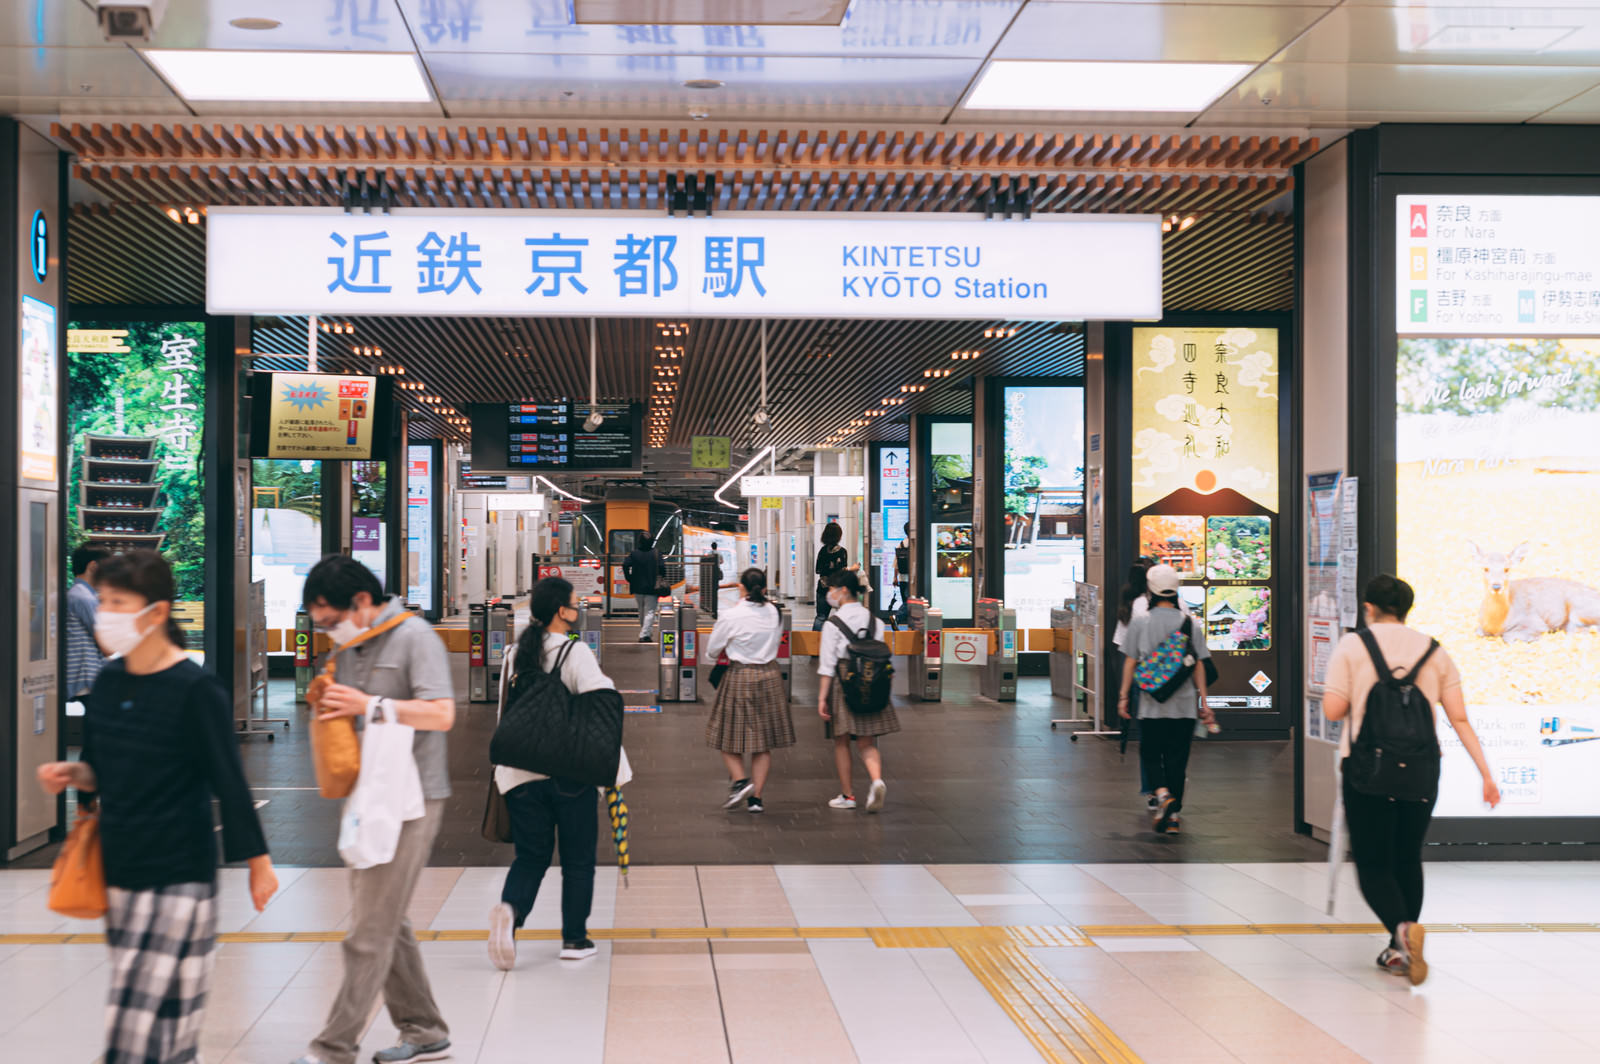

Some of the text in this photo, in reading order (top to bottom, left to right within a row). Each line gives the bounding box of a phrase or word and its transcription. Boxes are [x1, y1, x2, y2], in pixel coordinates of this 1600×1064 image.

[1412, 213, 1426, 230] A
[1436, 205, 1471, 222] 奈良
[1436, 225, 1496, 239] For Nara
[328, 231, 767, 299] 近鉄 京都駅
[843, 245, 981, 268] KINTETSU
[1412, 255, 1425, 272] B
[1437, 247, 1527, 265] 橿原神宮前
[1436, 266, 1593, 285] For Kashiharajingu-mae
[954, 276, 1048, 299] Station
[1413, 297, 1425, 315] F
[1436, 289, 1467, 307] 吉野
[1436, 309, 1503, 323] For Yoshino
[1542, 310, 1560, 324] For
[159, 334, 199, 451] 室生寺
[1424, 368, 1574, 405] We look forward
[1421, 456, 1466, 479] Nara
[663, 633, 675, 644] IC
[1511, 720, 1526, 730] on
[1500, 765, 1538, 785] 近鉄
